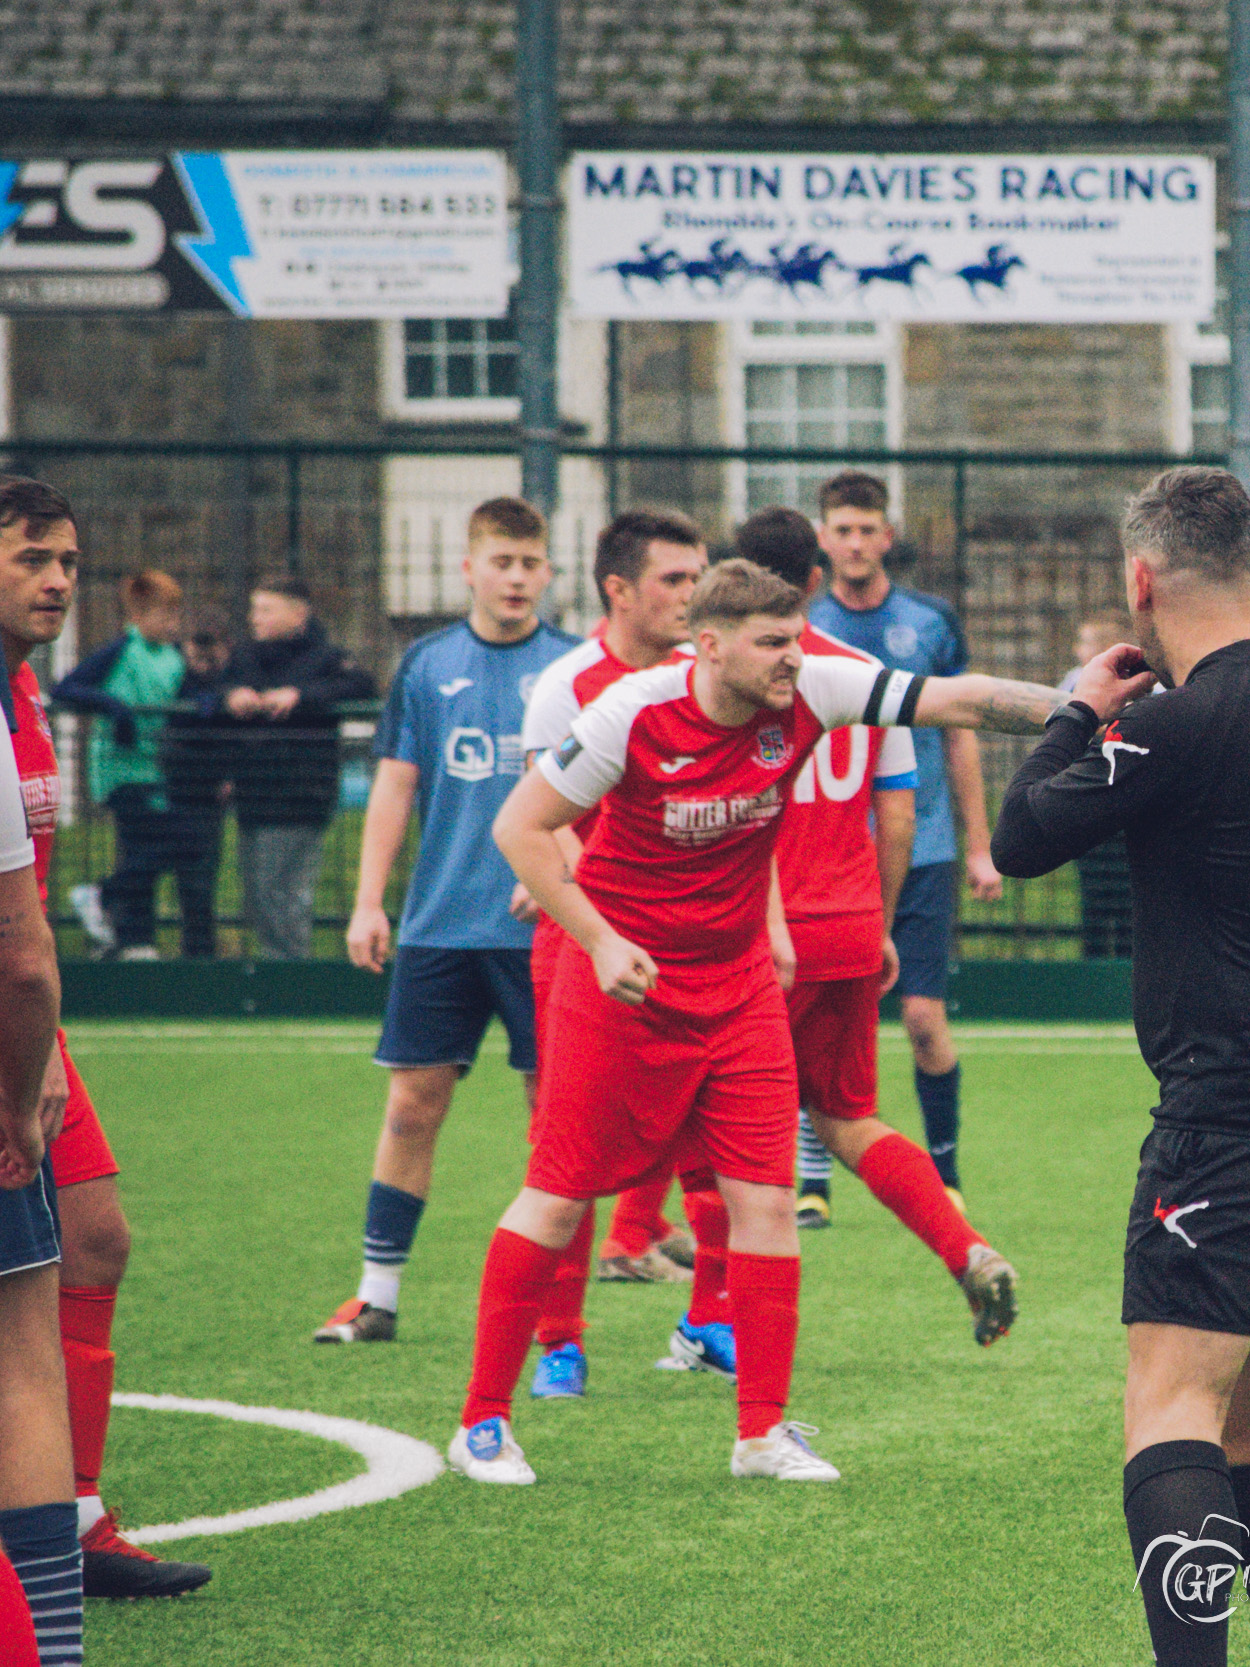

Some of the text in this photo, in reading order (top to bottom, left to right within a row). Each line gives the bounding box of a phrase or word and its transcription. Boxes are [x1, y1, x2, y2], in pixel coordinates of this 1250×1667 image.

[584, 163, 1199, 203] MARTIN DAVIES RACING
[968, 212, 1122, 233] Bookmaker
